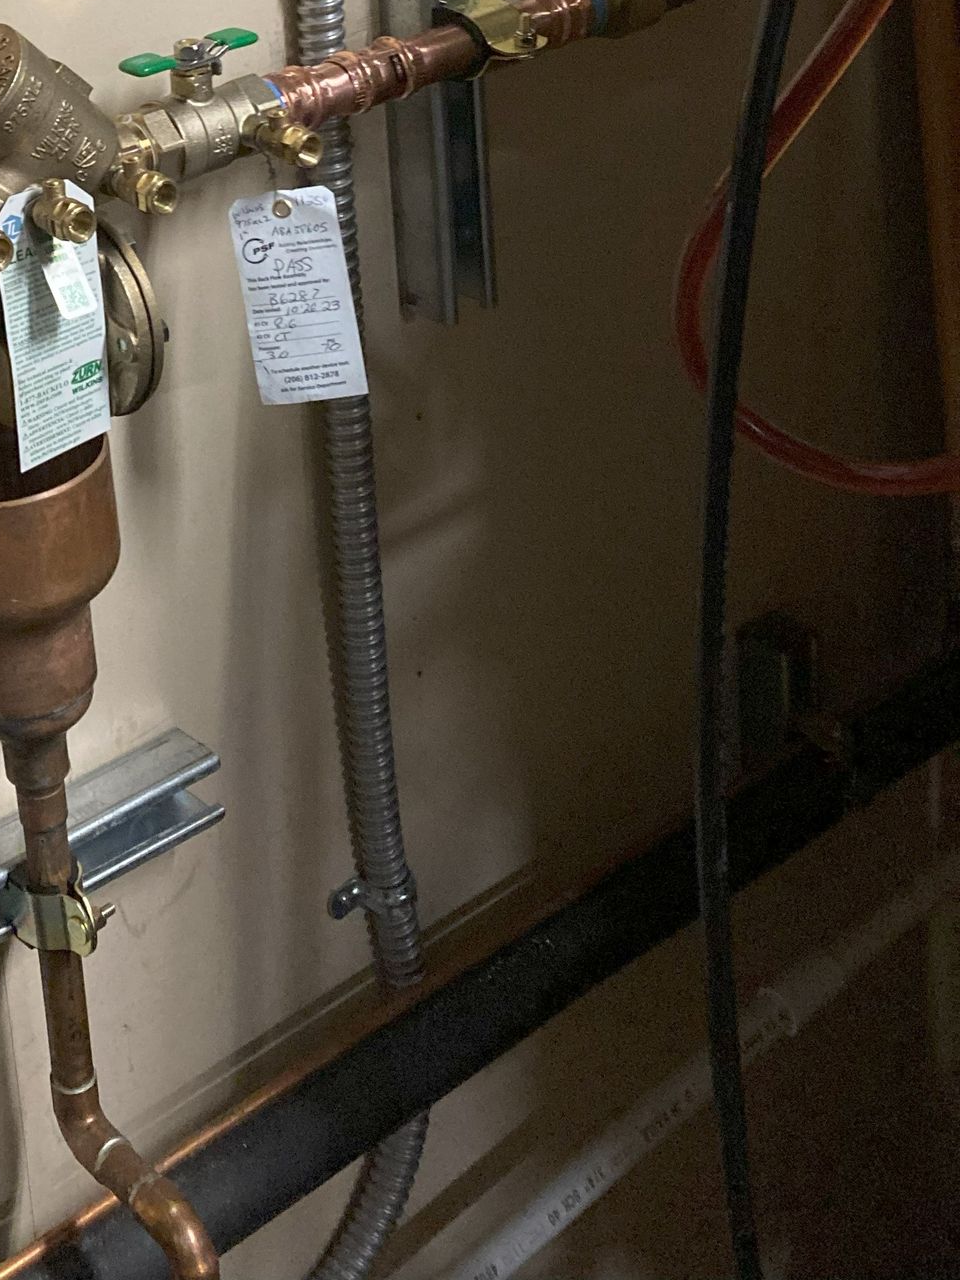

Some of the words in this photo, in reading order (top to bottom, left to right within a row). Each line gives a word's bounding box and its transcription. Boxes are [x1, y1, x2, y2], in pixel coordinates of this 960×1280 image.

[253, 242, 274, 255] PSF
[273, 256, 313, 276] PASS
[73, 360, 103, 382] ZURN
[72, 376, 103, 395] WILKINS
